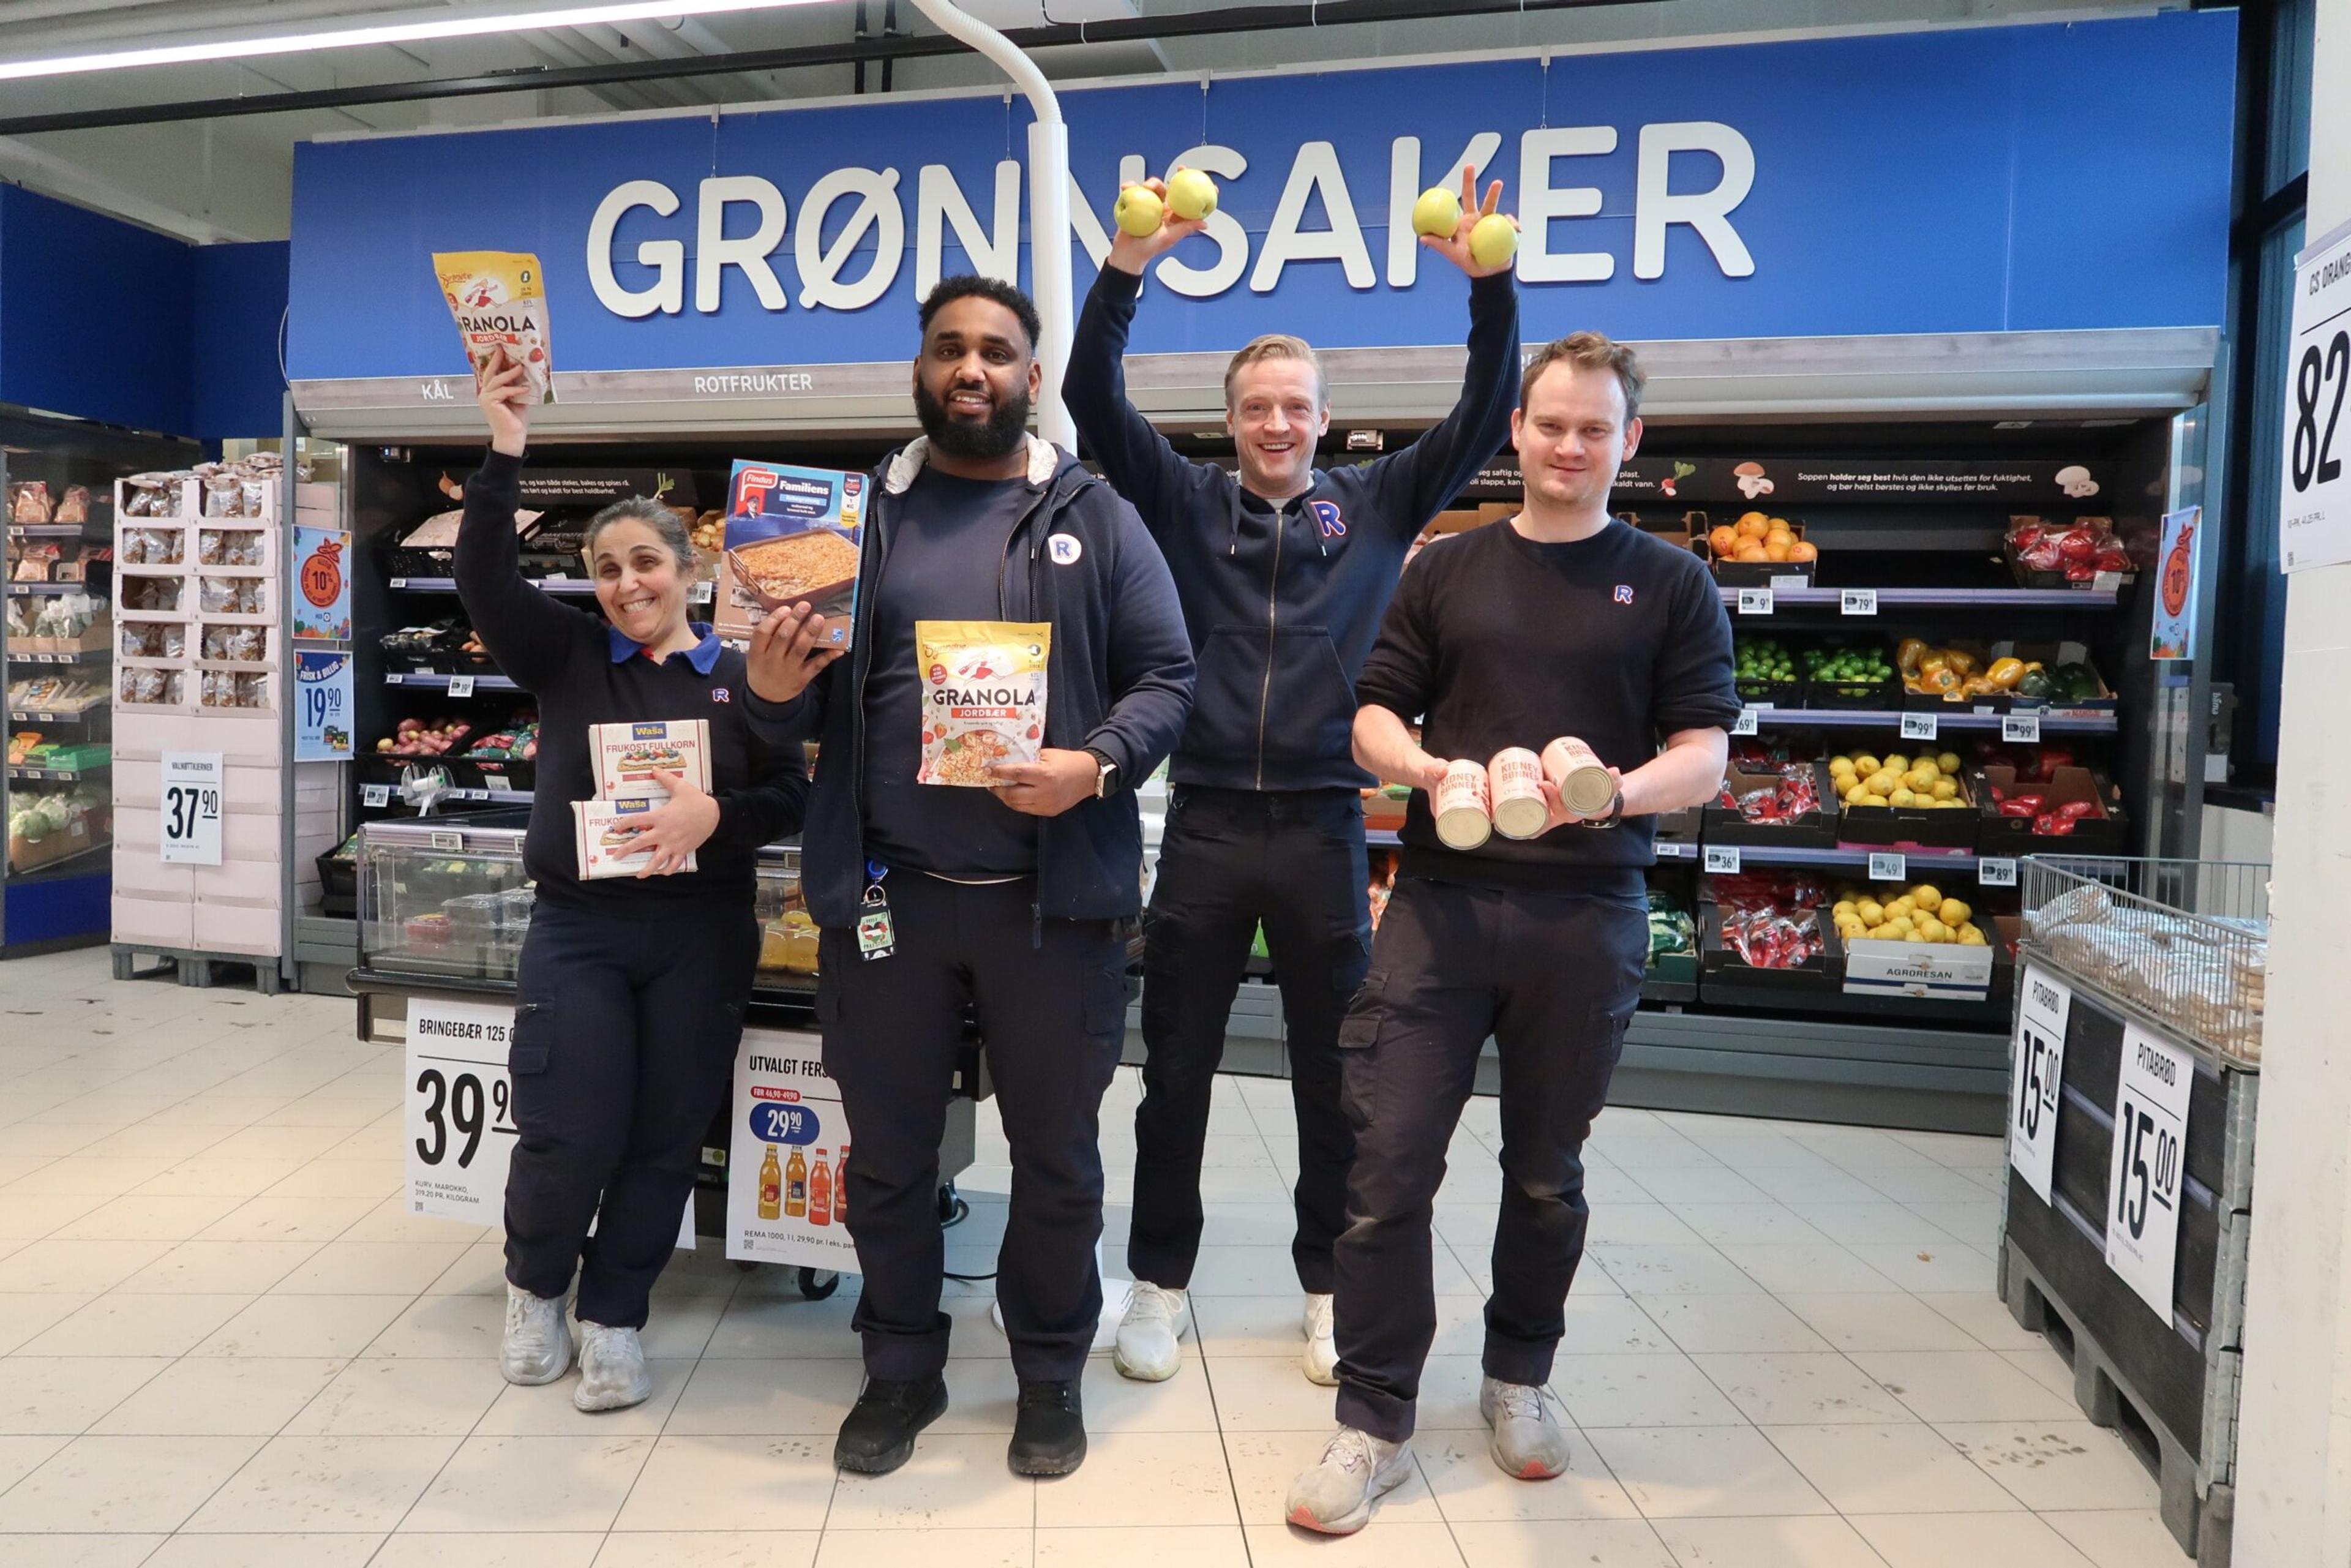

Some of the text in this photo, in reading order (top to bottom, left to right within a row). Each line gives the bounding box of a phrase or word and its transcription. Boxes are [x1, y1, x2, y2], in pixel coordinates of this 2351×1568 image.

[2309, 270, 2320, 296] CS
[459, 315, 536, 333] RANOLA
[421, 379, 454, 400] KÅL
[694, 373, 814, 393] ROTFRUKTER
[2292, 330, 2350, 493] 82
[746, 474, 773, 484] Findus
[1491, 468, 1512, 478] saftig
[1619, 470, 1640, 479] plast.
[1798, 473, 1828, 482] Soppen
[1857, 474, 1872, 482] seg
[1993, 474, 2033, 483] fuktighet,
[779, 480, 830, 495] Familiens
[1480, 478, 1506, 487] slappe,
[1936, 484, 1962, 492] skylles
[1310, 500, 1346, 538] R
[1054, 540, 1073, 558] R
[312, 570, 328, 591] 10
[1614, 584, 1633, 604] R
[1858, 598, 1869, 611] 79
[713, 688, 730, 703] R
[932, 688, 1036, 706] GRANOLA
[306, 687, 341, 728] 19 90
[959, 708, 1007, 717] JORDBÆR
[635, 727, 664, 736] Wasa
[1739, 719, 1750, 730] 69
[1917, 722, 1929, 735] 99
[2020, 726, 2031, 738] 99
[606, 740, 696, 754] FRUKOST FULLKORN
[167, 786, 218, 839] 37 90
[1721, 856, 1733, 869] 36
[1885, 864, 1897, 876] 49
[1996, 868, 2009, 880] 89
[1886, 968, 1952, 979] AGRORESAN
[2032, 980, 2060, 1015] PITABRØD
[419, 1019, 482, 1040] BRINGEBÆR
[486, 1025, 505, 1042] 125
[749, 1055, 798, 1076] UTVALGT
[2137, 1043, 2177, 1087] PITABRØD
[753, 1087, 765, 1097] FØR
[2019, 1029, 2059, 1141] 15 00
[416, 1068, 509, 1169] 39 9
[767, 1109, 802, 1138] 29 90
[2118, 1100, 2177, 1240] 15 00
[435, 1183, 468, 1195] MAROKKO,
[446, 1193, 480, 1204] KILOGRAM
[744, 1229, 766, 1238] REMA
[767, 1232, 786, 1242] 1000,
[797, 1235, 815, 1245] 29,90
